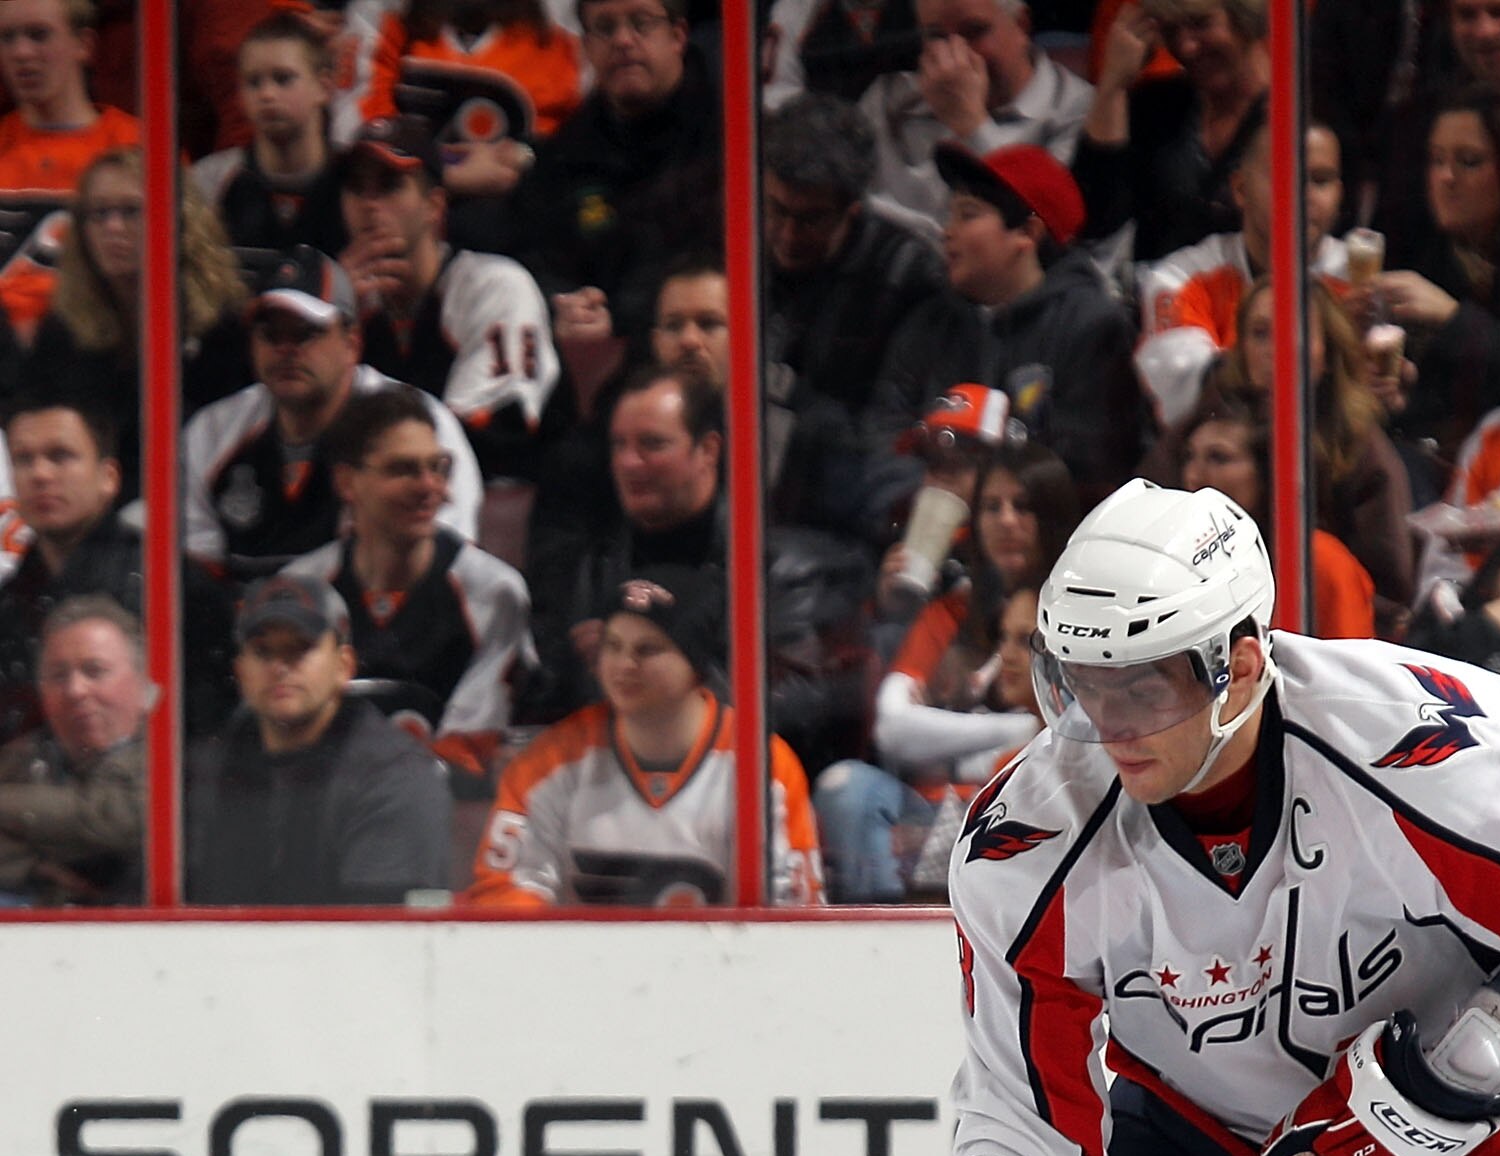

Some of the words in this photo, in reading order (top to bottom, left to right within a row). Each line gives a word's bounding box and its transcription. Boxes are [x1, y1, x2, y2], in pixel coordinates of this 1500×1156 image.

[1057, 623, 1112, 639] CCM
[1290, 796, 1324, 871] C
[1381, 1106, 1456, 1153] CCM
